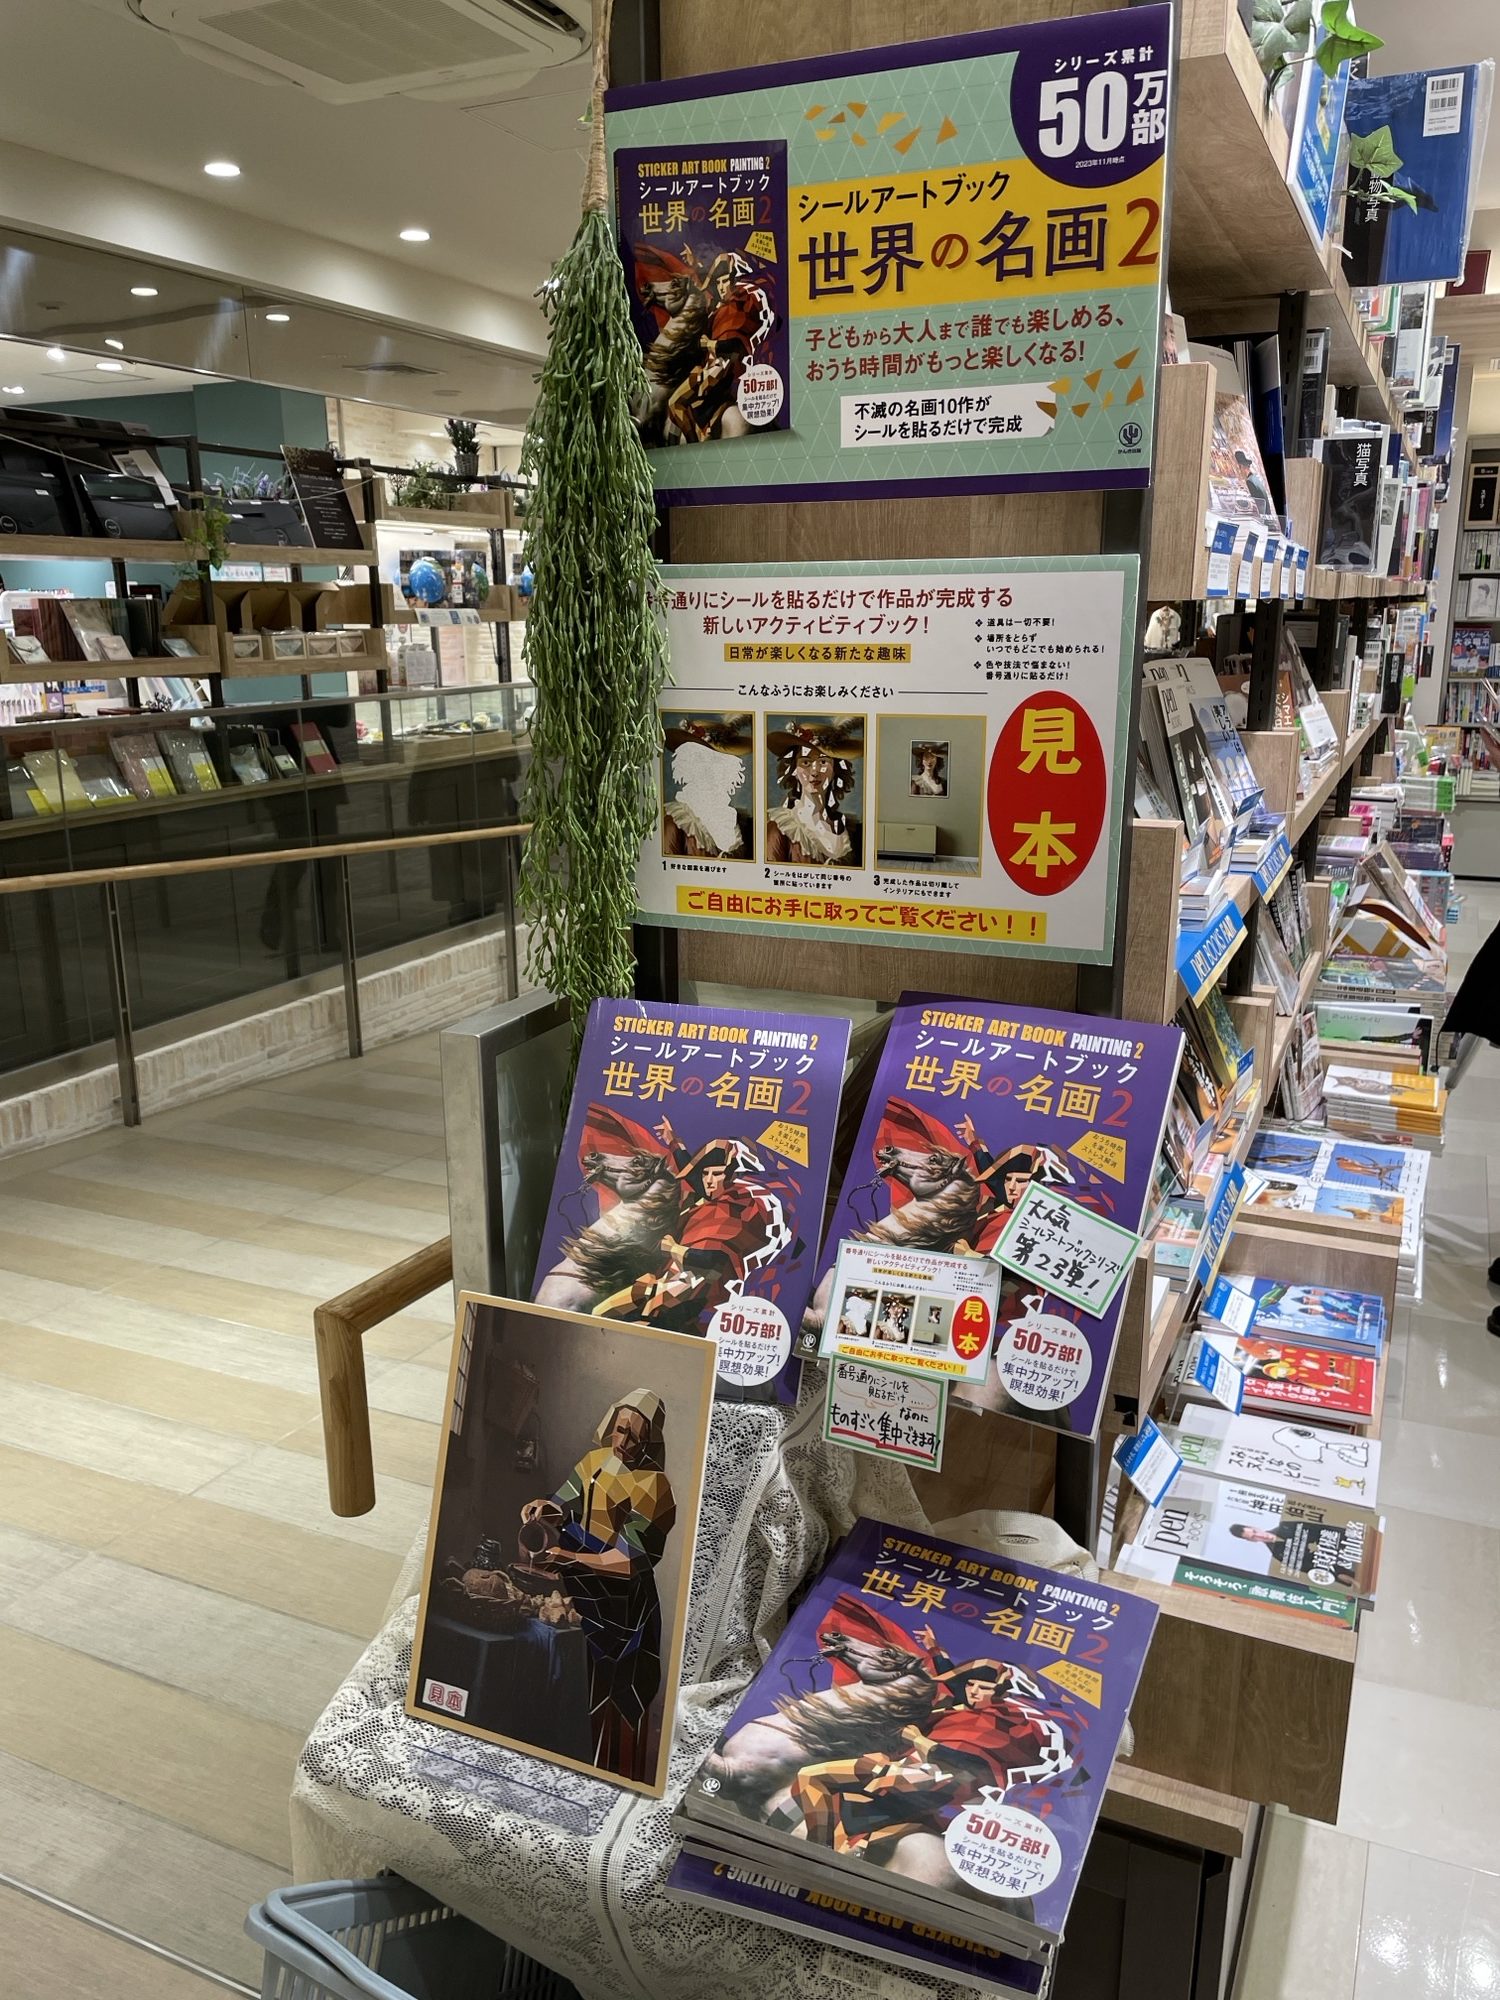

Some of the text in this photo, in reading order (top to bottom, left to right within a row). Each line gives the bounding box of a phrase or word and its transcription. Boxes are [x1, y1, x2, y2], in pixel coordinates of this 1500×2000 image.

[1054, 45, 1154, 73] シリーズ累計
[638, 156, 771, 178] STICKER ART BOOK PAINTING 2
[1075, 155, 1125, 169] 2023年11月時点
[640, 173, 770, 199] シールアートブック
[798, 170, 1011, 223] シールアートブック
[638, 195, 773, 235] 世界の名画2
[798, 198, 1161, 300] 世界の名画2
[805, 304, 1125, 352] 子どもから大人まで誰でも楽しめる、
[806, 340, 1086, 383] おうち時間がもっと楽しくなる！
[743, 378, 778, 394] 50万部！
[854, 395, 992, 421] 不滅の名画10作が
[855, 415, 1023, 442] シールを貼るだけで完成
[1353, 442, 1372, 487] 猫写真
[703, 615, 929, 635] 新しいアクティビティブック！
[987, 618, 1055, 627] 道具は一切不要！
[987, 633, 1037, 643] 場所をとらず
[730, 645, 907, 661] 日常が楽しくなる新たな趣味
[987, 645, 1105, 654] いつでもどこでも始められる！
[738, 684, 894, 698] こんなふうにお楽しみください
[986, 672, 1069, 681] 番号通りに貼るだけ！
[1010, 706, 1082, 878] 見本
[662, 861, 667, 871] 1
[764, 867, 770, 878] 2
[873, 875, 880, 886] 3
[883, 887, 952, 898] インテリアにもできます
[688, 889, 1038, 936] ご自由にお手に取ってご覧ください！！
[1202, 928, 1228, 966] BOOKS
[1220, 915, 1238, 943] FAIR
[613, 1016, 819, 1050] STICKER ART BOOK PAINTING 2
[920, 1010, 1145, 1060] STICKER ART BOOK PAINTING 2
[610, 1035, 815, 1075] シールアートブック
[915, 1029, 1138, 1084] シールアートブック
[602, 1061, 812, 1117] 世界の名画2
[905, 1055, 1133, 1129] 世界の名画2
[1210, 1199, 1230, 1247] BOOKS
[720, 1311, 782, 1341] 50万部！
[957, 1299, 984, 1355] 見本
[1013, 1327, 1083, 1365] 50万部！
[837, 1363, 910, 1393] 番号通りにシールを
[1002, 1361, 1079, 1393] 集中力アップ！
[1011, 1353, 1077, 1378] シールを貼るだけで
[900, 1407, 929, 1423] なのに
[1179, 1435, 1207, 1465] pen
[1230, 1450, 1302, 1471] みんなの
[1154, 1507, 1190, 1549] pen
[1186, 1511, 1207, 1542] BOOKS
[875, 1551, 1115, 1631] シールアートブック
[883, 1536, 1120, 1617] STICKER ART BOOK PAINTING 2
[861, 1567, 1110, 1664] 世界の名画2
[428, 1682, 463, 1712] 見本
[966, 1813, 1051, 1859] 50万部！
[951, 1842, 1045, 1886] 集中力アップ！
[962, 1836, 1042, 1870] シールを貼るだけで
[959, 1859, 1028, 1894] 瞑想効果！
